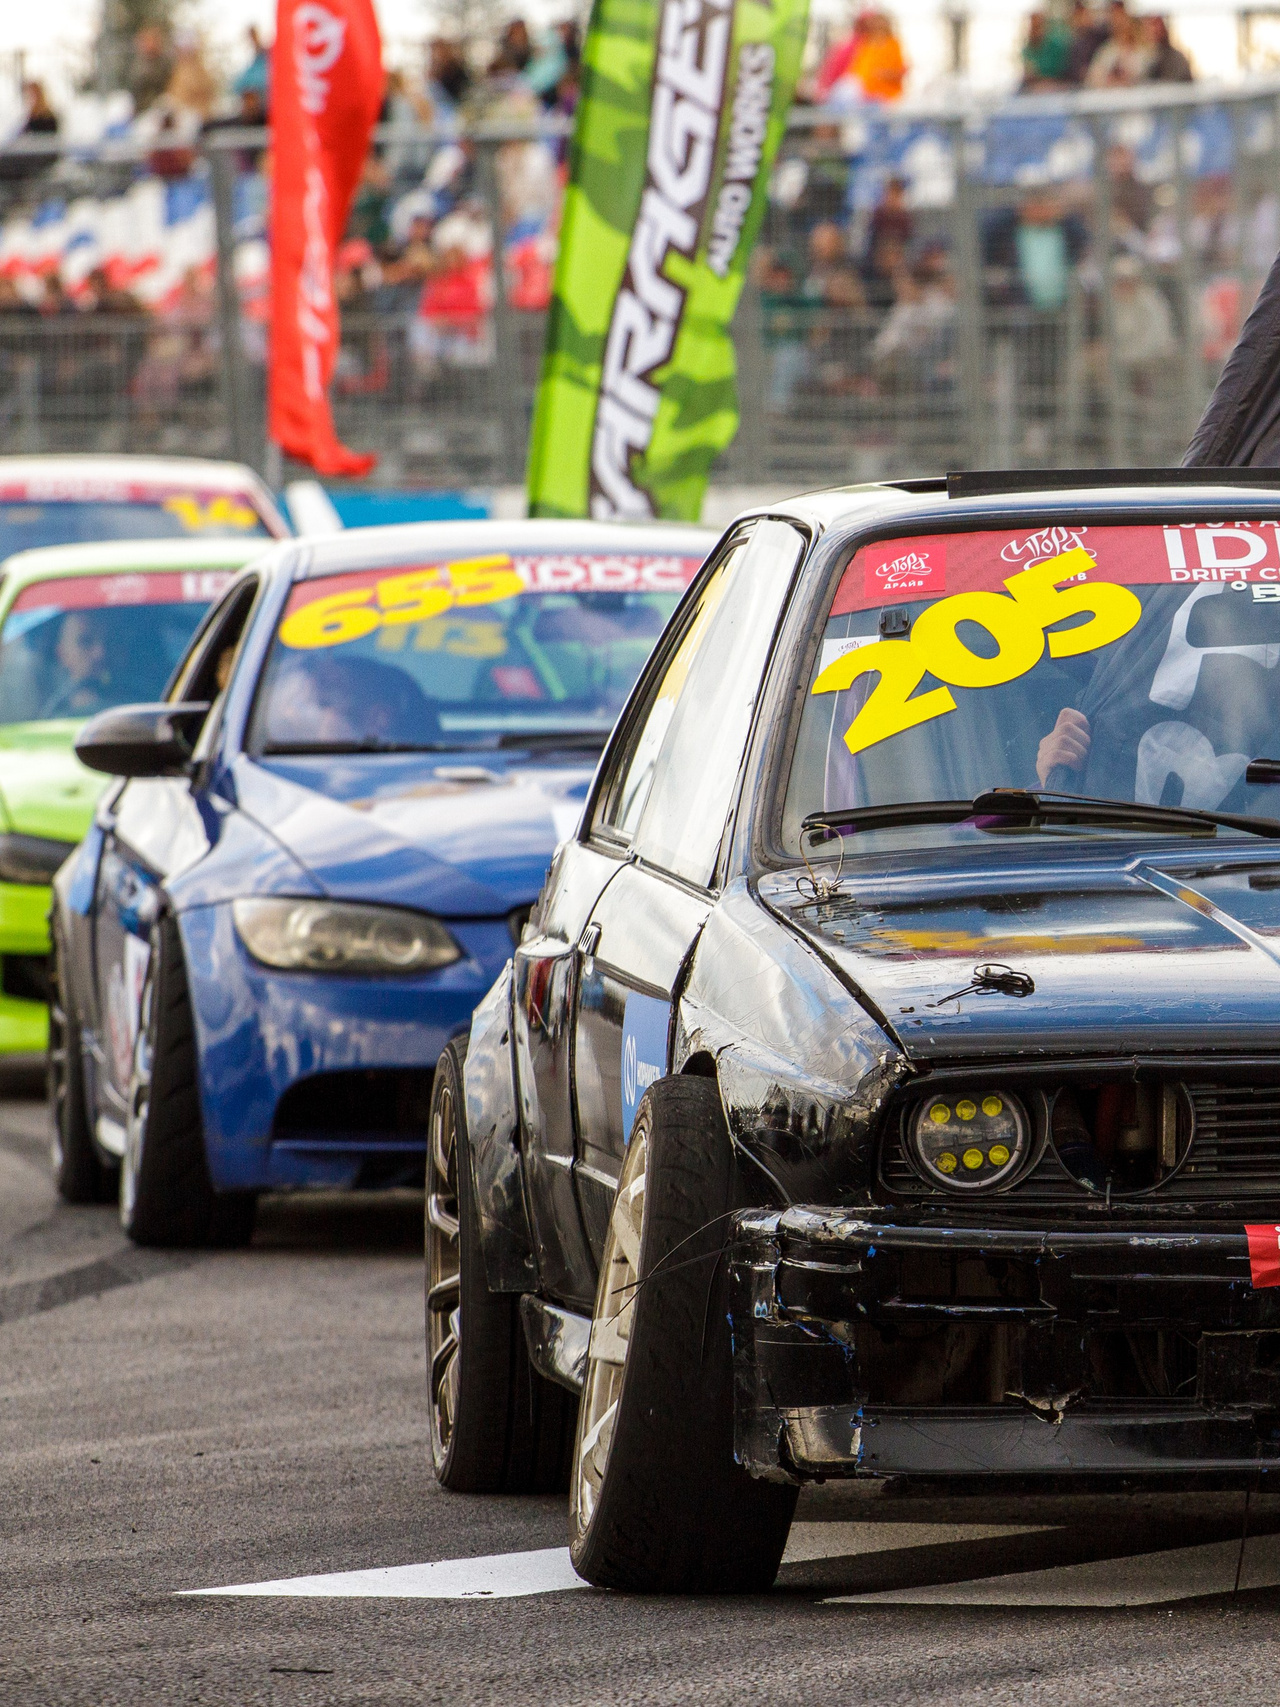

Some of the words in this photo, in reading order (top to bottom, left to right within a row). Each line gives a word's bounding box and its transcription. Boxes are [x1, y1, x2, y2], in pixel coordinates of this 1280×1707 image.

[725, 43, 776, 179] WORKS
[279, 553, 525, 649] 655
[882, 579, 925, 590] ДРАЙВ
[1170, 567, 1252, 582] DRIFT
[811, 546, 1142, 755] 205
